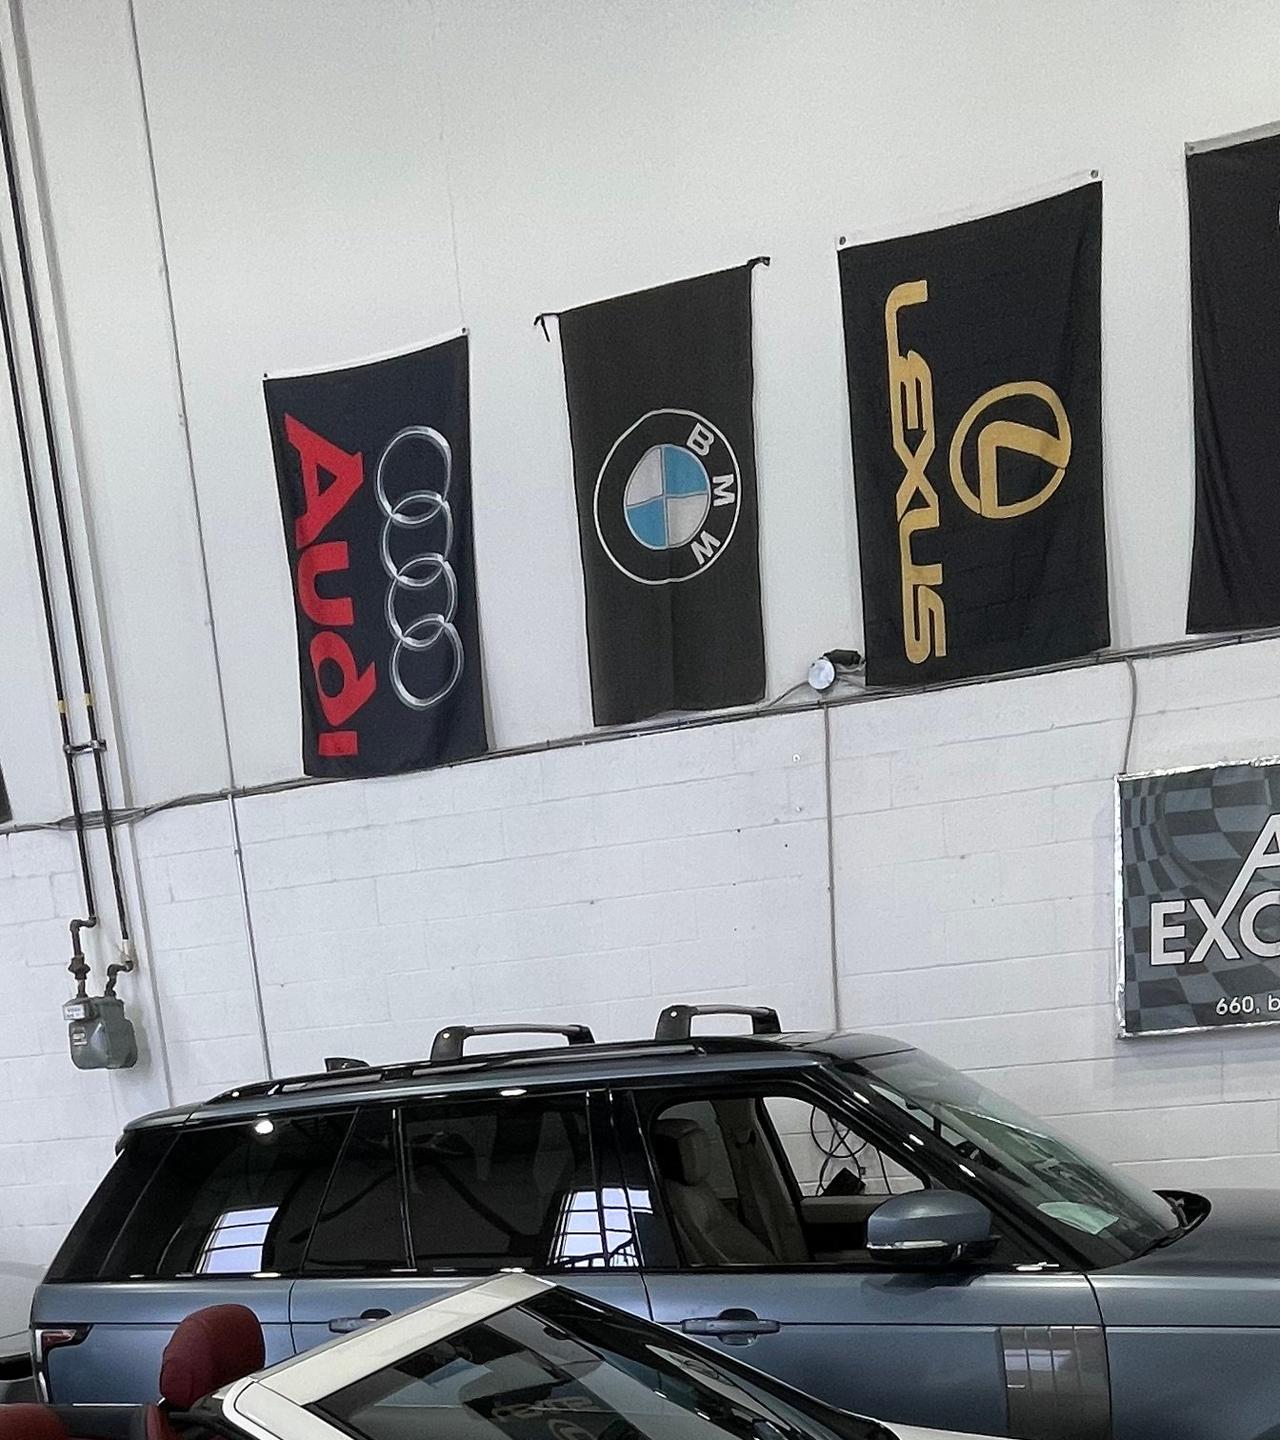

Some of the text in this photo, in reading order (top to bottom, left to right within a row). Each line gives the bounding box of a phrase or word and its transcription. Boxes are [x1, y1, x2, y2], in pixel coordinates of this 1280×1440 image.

[686, 422, 736, 565] BMW
[884, 279, 947, 665] LEXUS
[1215, 994, 1261, 1016] 660,
